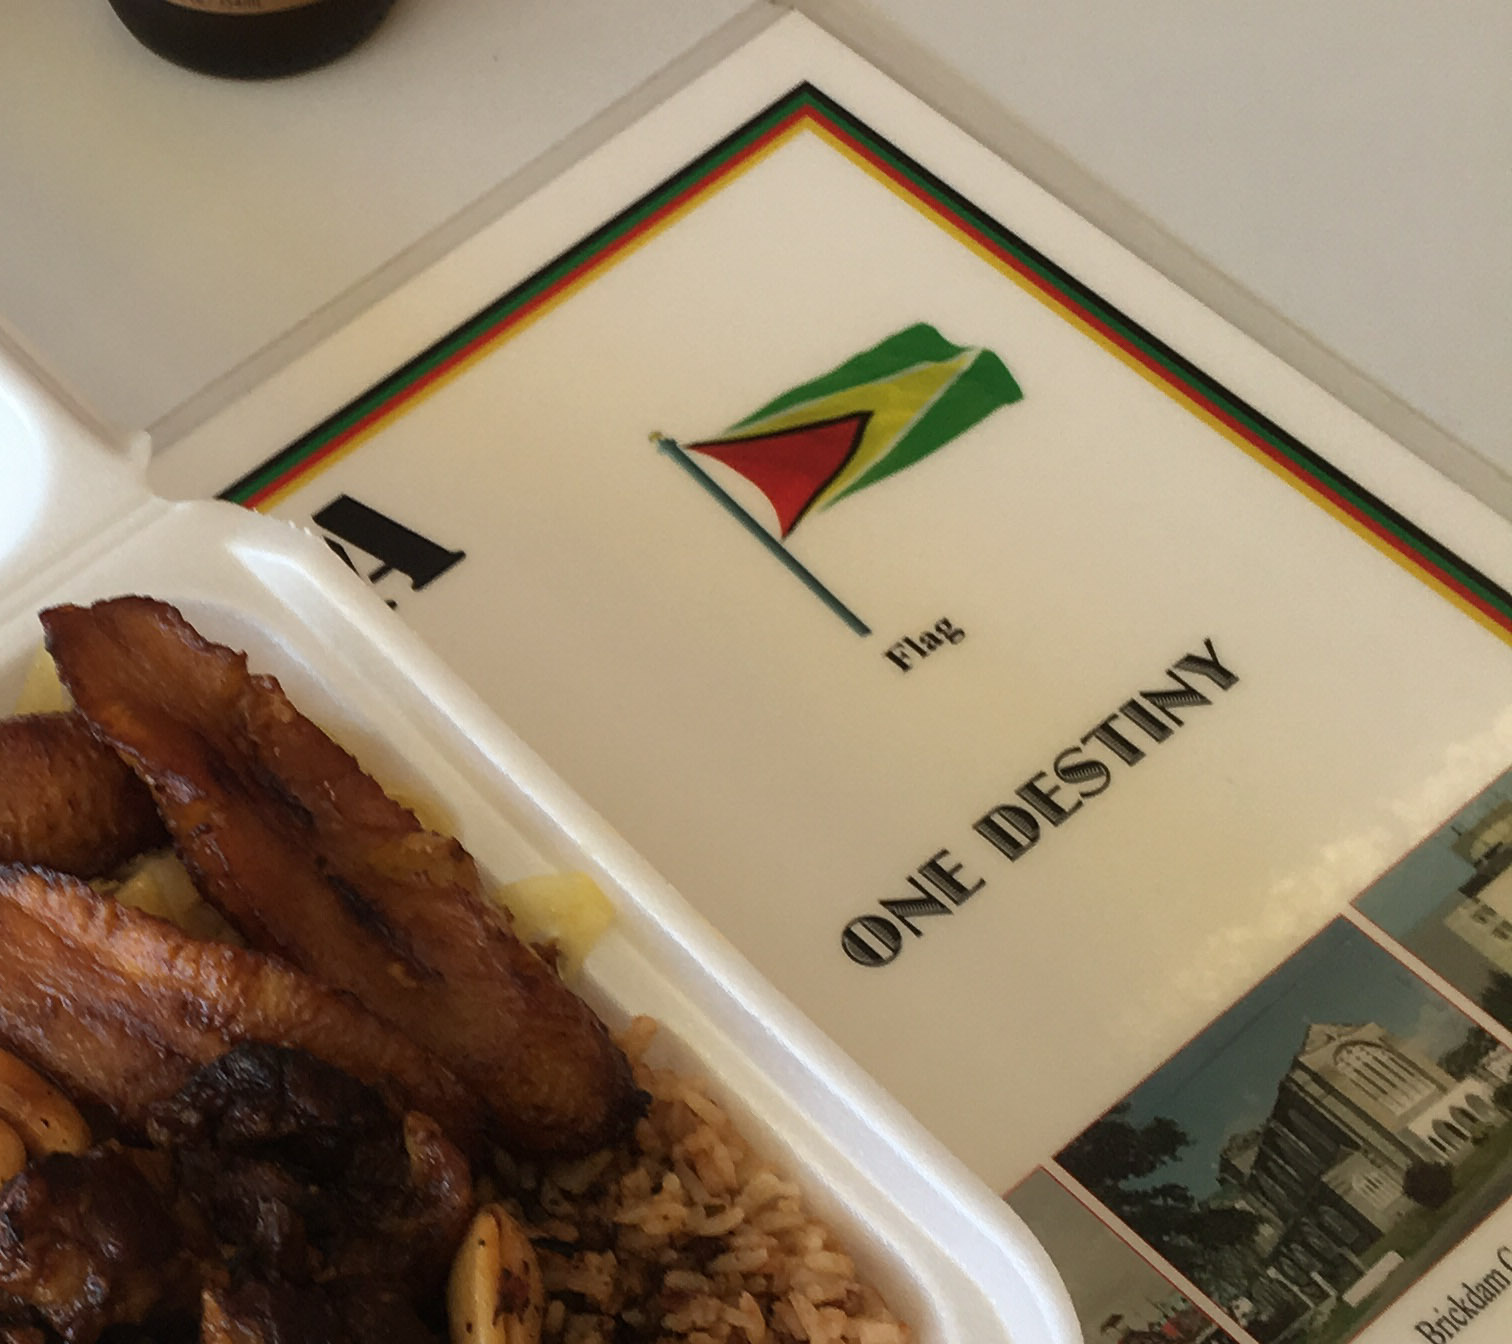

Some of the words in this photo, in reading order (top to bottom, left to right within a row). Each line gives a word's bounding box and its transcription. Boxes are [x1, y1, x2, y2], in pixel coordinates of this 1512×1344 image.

[883, 613, 968, 677] Flag
[840, 848, 986, 972] ONE
[971, 636, 1241, 864] DESTINY
